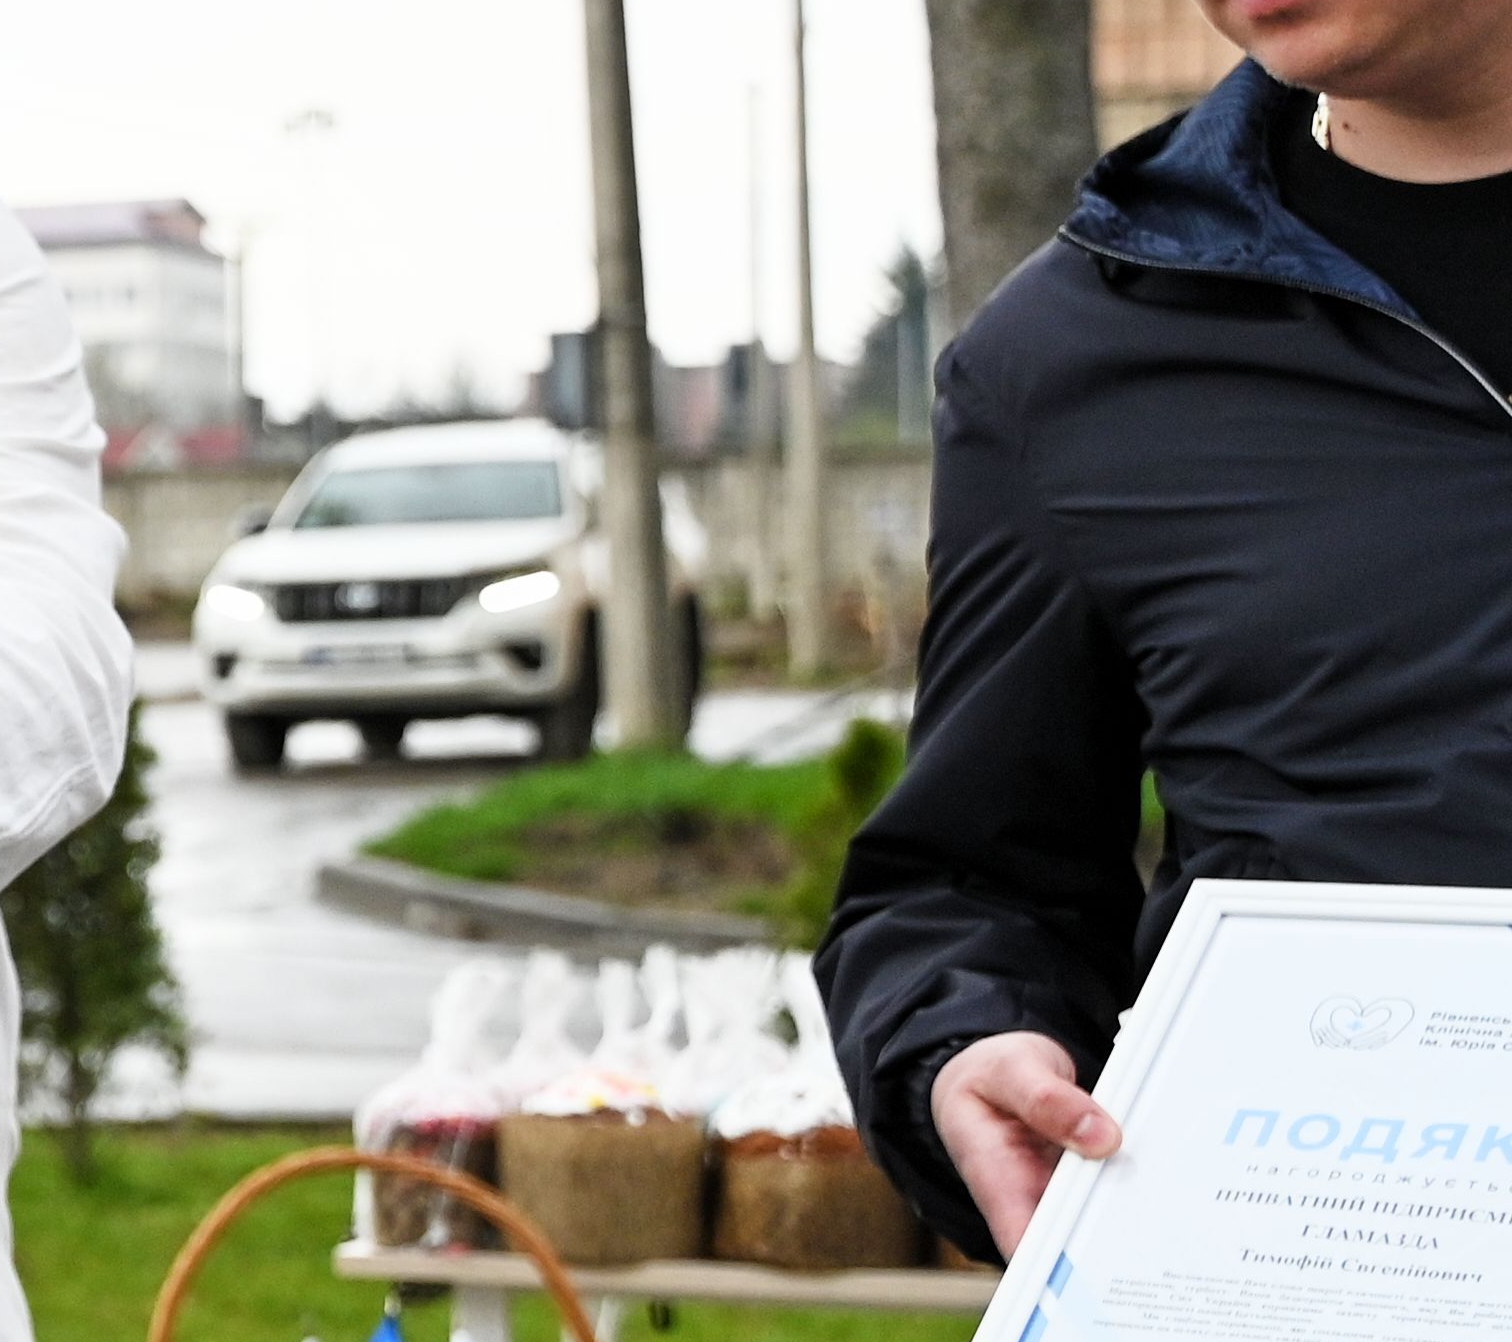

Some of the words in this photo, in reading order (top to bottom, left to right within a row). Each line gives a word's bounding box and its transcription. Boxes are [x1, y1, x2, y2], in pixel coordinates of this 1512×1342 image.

[1425, 1025, 1503, 1037] Клінічна
[1215, 1189, 1366, 1212] ПРИВАТНИЙ
[1372, 1200, 1512, 1225] ПІДПРИЄМ
[1240, 1249, 1332, 1271] Тимофій
[1341, 1258, 1483, 1283] Євгенійович
